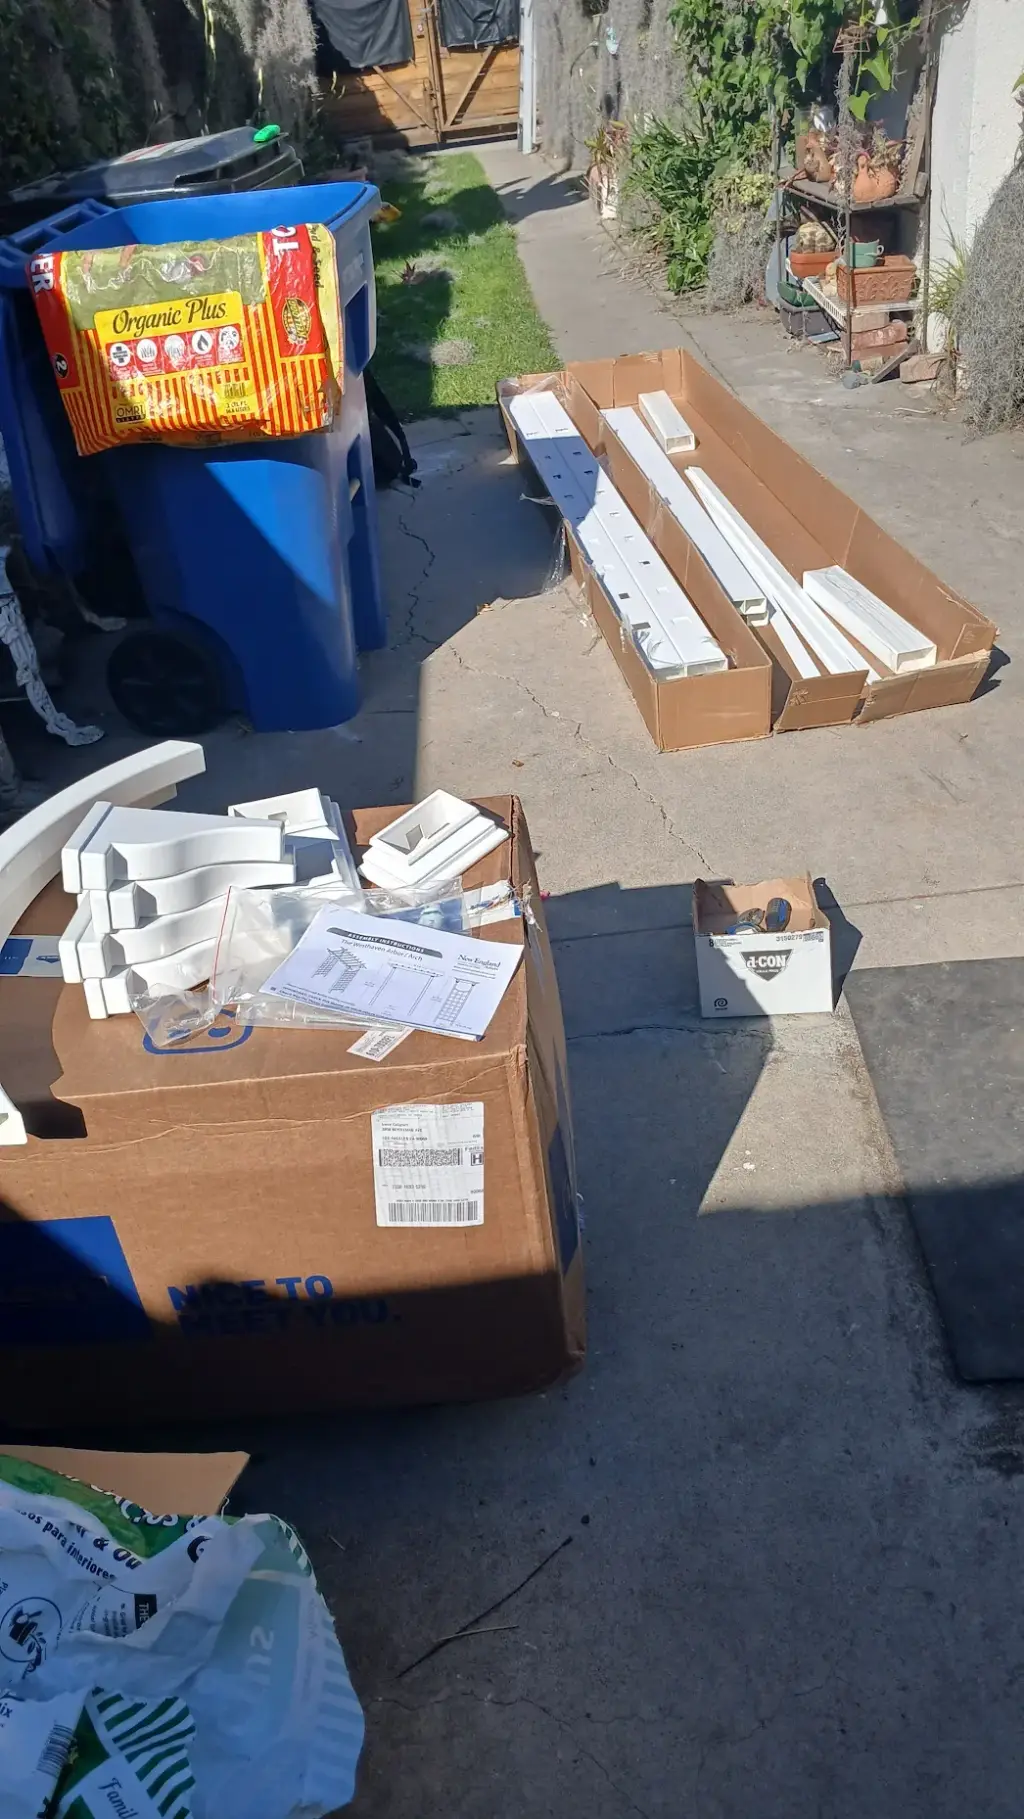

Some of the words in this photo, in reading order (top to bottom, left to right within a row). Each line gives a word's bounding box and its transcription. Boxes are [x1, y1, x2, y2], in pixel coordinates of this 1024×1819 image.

[31, 253, 55, 293] ER
[113, 309, 182, 338] Organic
[185, 298, 227, 325] Plus
[116, 402, 145, 417] OMRI
[348, 933, 380, 943] ASSEMBLY
[380, 938, 425, 954] INSTRUCTIONS
[457, 954, 473, 963] New
[473, 957, 501, 968] England
[276, 1275, 334, 1301] TO
[42, 1521, 67, 1548] para
[67, 1542, 117, 1581] interiores
[0, 1703, 13, 1719] ix
